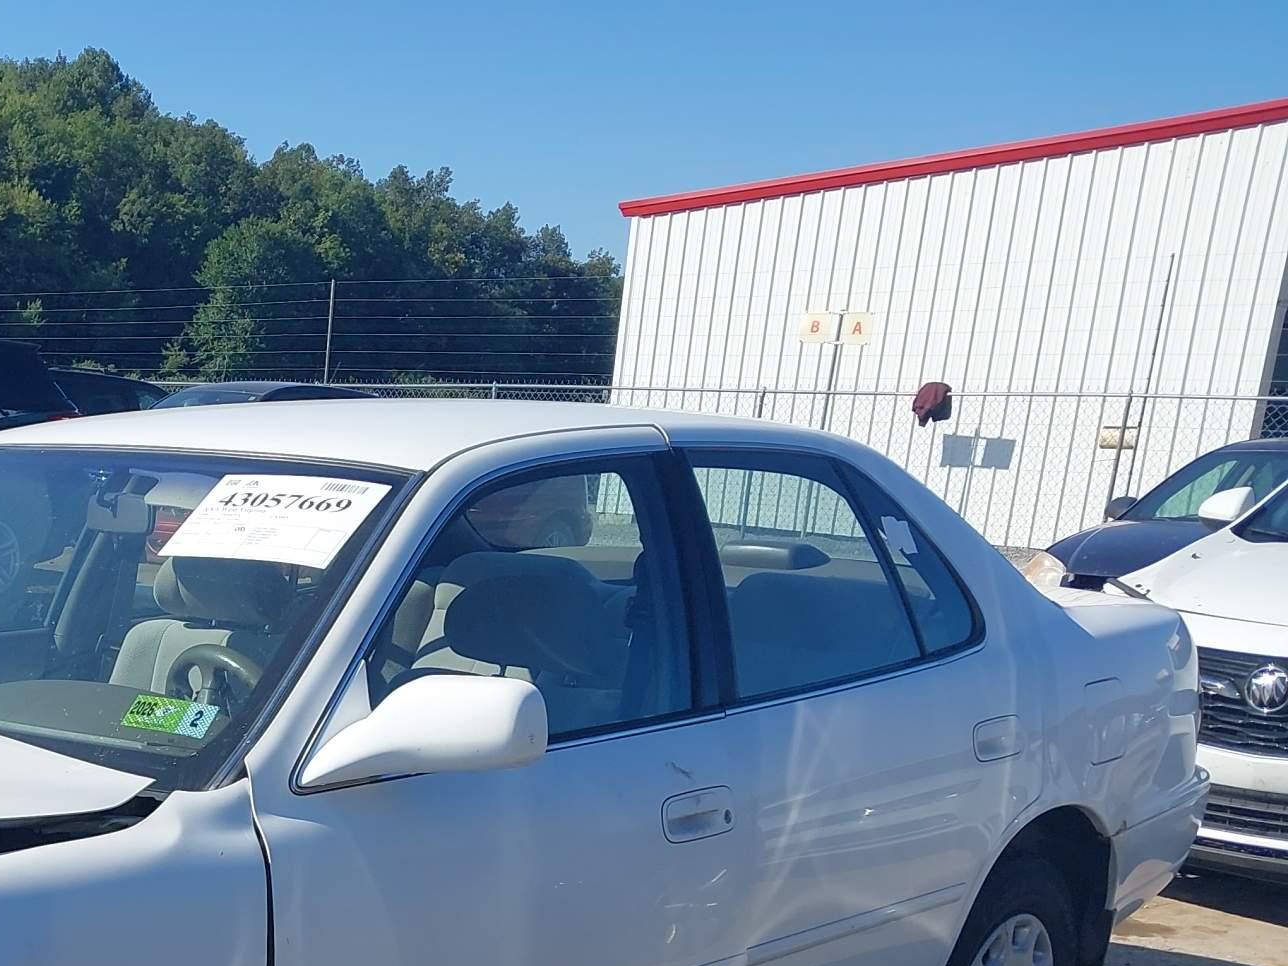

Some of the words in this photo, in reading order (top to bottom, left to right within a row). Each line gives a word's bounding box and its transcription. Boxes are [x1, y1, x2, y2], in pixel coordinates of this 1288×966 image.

[810, 320, 820, 333] B
[852, 321, 862, 335] A
[219, 492, 352, 513] 43057669
[190, 710, 203, 727] 2
